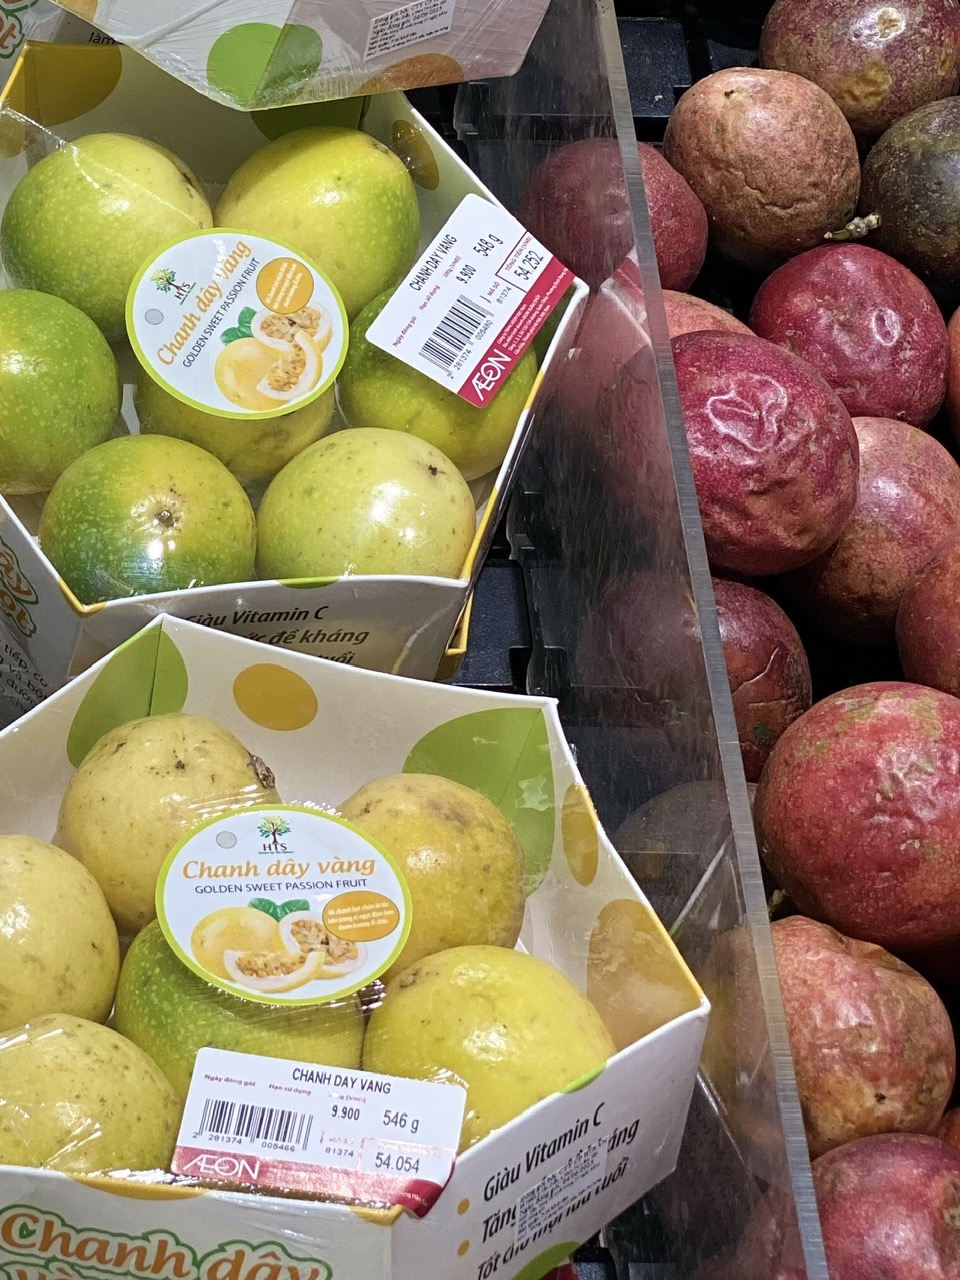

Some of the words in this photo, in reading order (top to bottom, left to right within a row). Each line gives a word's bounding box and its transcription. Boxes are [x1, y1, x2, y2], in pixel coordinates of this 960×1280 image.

[410, 265, 432, 291] CHANH
[428, 250, 443, 270] DAY
[438, 234, 458, 255] VANG
[456, 264, 477, 284] 9.900
[473, 239, 495, 257] 548
[489, 233, 503, 245] g
[514, 250, 544, 280] 54.252
[157, 311, 201, 366] Chanh
[197, 280, 223, 313] dây
[216, 240, 252, 279] vàng
[174, 282, 191, 300] HTS
[183, 335, 209, 368] GOLDEN
[207, 310, 225, 337] SWEET
[221, 279, 247, 312] PASSION
[243, 257, 260, 281] FRUIT
[232, 608, 309, 624] Vitamin
[314, 606, 328, 620] C
[4, 645, 29, 673] tiếp,
[263, 843, 287, 851] HTS
[183, 860, 260, 880] Chanh
[267, 859, 310, 878] dây
[318, 857, 376, 876] vàng
[195, 884, 243, 894] GOLDEN
[245, 883, 282, 892] SWEET
[285, 880, 333, 890] PASSION
[336, 879, 368, 888] FRUIT
[292, 1067, 331, 1086] CHANH
[334, 1075, 359, 1089] DAY
[361, 1079, 391, 1094] VANG
[331, 1105, 360, 1120] 9.900
[383, 1110, 407, 1128] 546
[411, 1118, 419, 1133] g
[375, 1152, 420, 1173] 54.054
[483, 1163, 521, 1202] Giàu
[526, 1118, 589, 1172] Vitamin
[594, 1102, 604, 1126] C
[1, 1213, 190, 1277] Chanh
